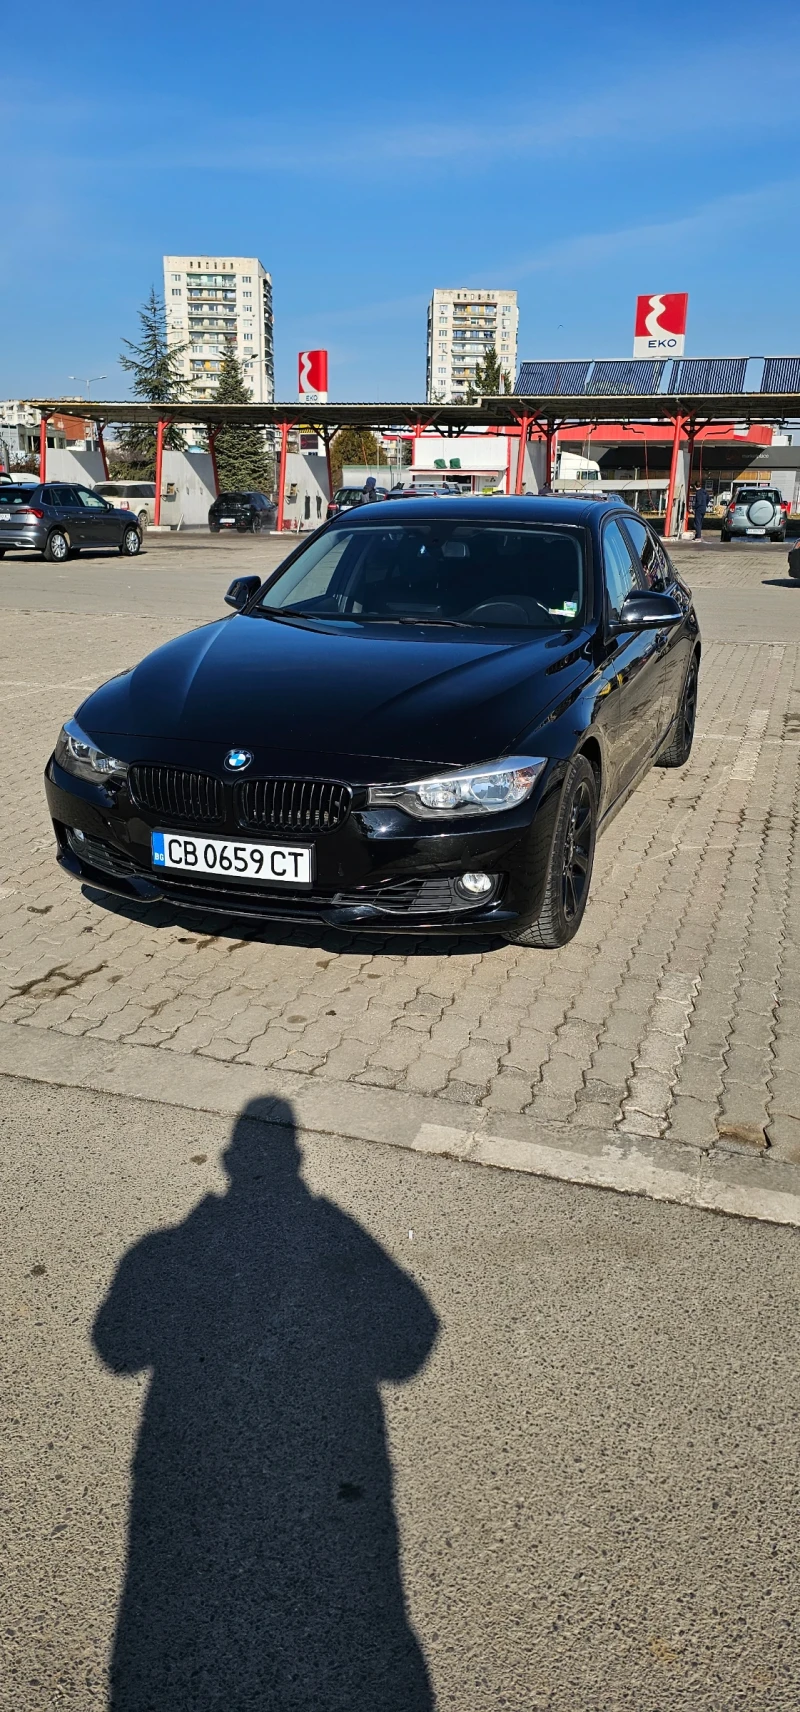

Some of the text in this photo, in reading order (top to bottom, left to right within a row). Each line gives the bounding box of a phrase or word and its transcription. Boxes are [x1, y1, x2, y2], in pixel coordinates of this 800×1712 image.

[648, 339, 677, 348] EKO
[154, 852, 164, 861] BG
[168, 839, 304, 877] CB 0659 CT
